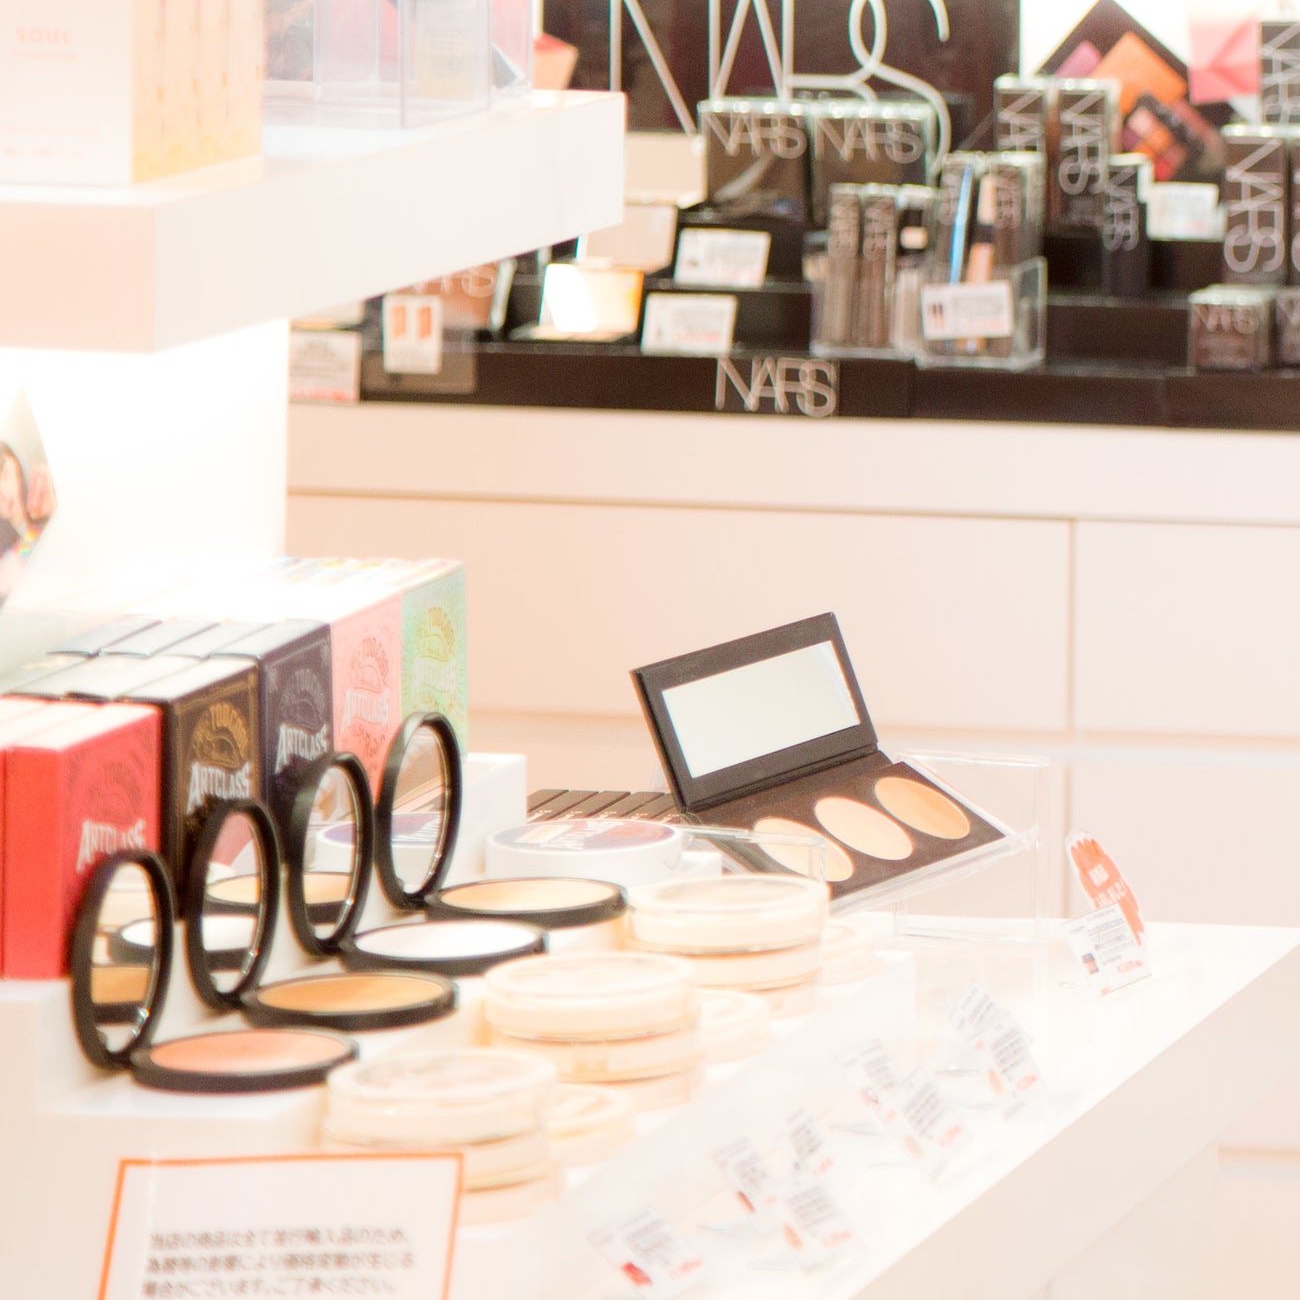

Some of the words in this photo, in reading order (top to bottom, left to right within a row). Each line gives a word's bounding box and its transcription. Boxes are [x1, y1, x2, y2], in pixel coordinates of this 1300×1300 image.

[1058, 89, 1109, 196] NARS
[1223, 137, 1286, 273] NARS
[715, 356, 837, 419] NARS
[274, 722, 329, 774] ARTCLASS
[186, 760, 252, 816] ARTCLASS
[76, 819, 146, 875] ARTCLASS
